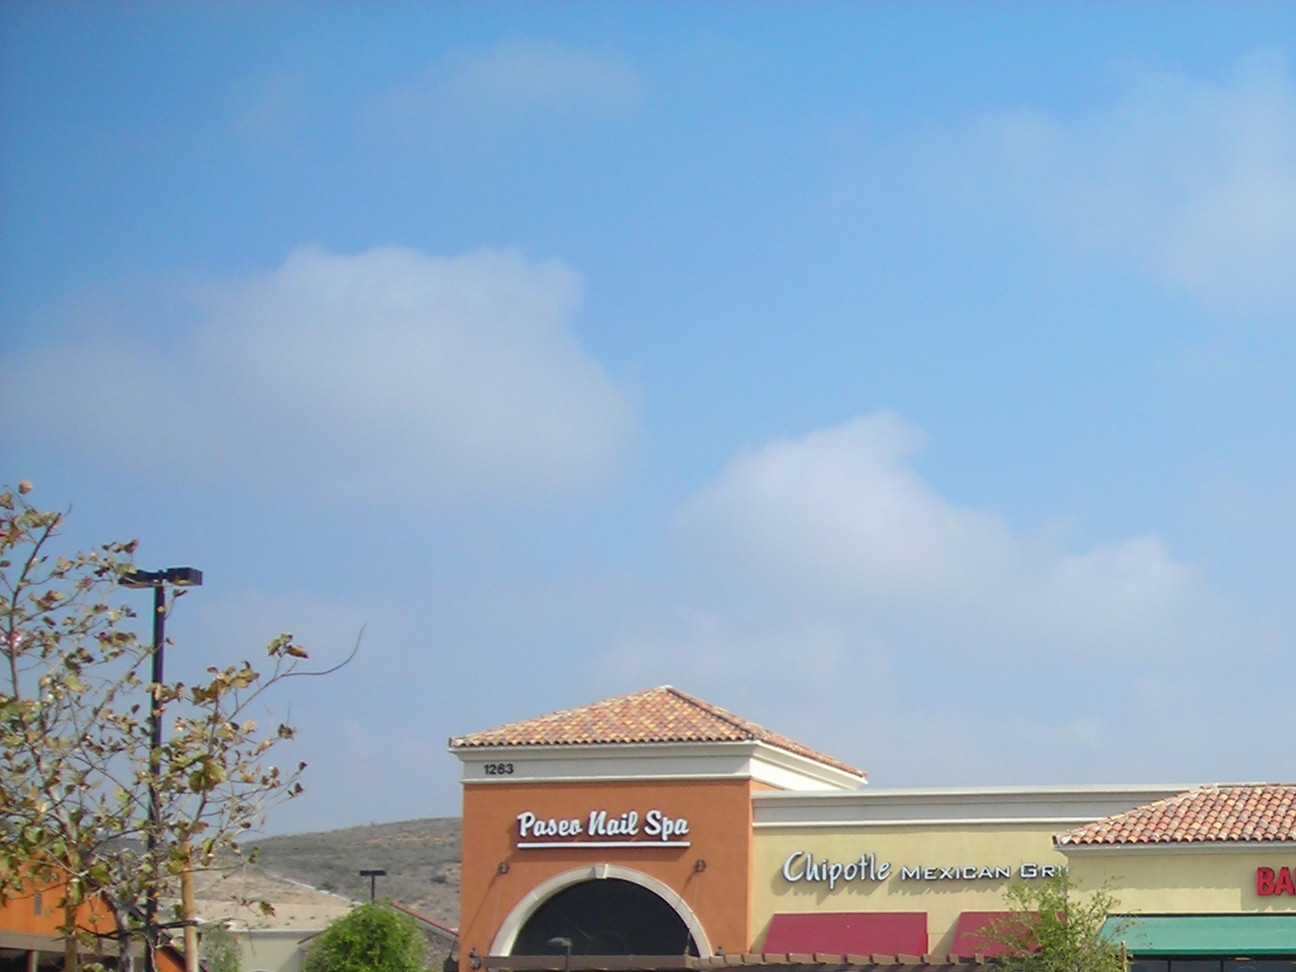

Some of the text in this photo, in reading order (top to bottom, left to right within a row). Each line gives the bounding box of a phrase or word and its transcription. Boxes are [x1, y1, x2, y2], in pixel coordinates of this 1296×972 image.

[484, 763, 514, 775] 1263
[516, 810, 690, 842] Paseo Nail Spa
[783, 850, 893, 890] Chipotle
[901, 864, 1013, 881] MEXICAN
